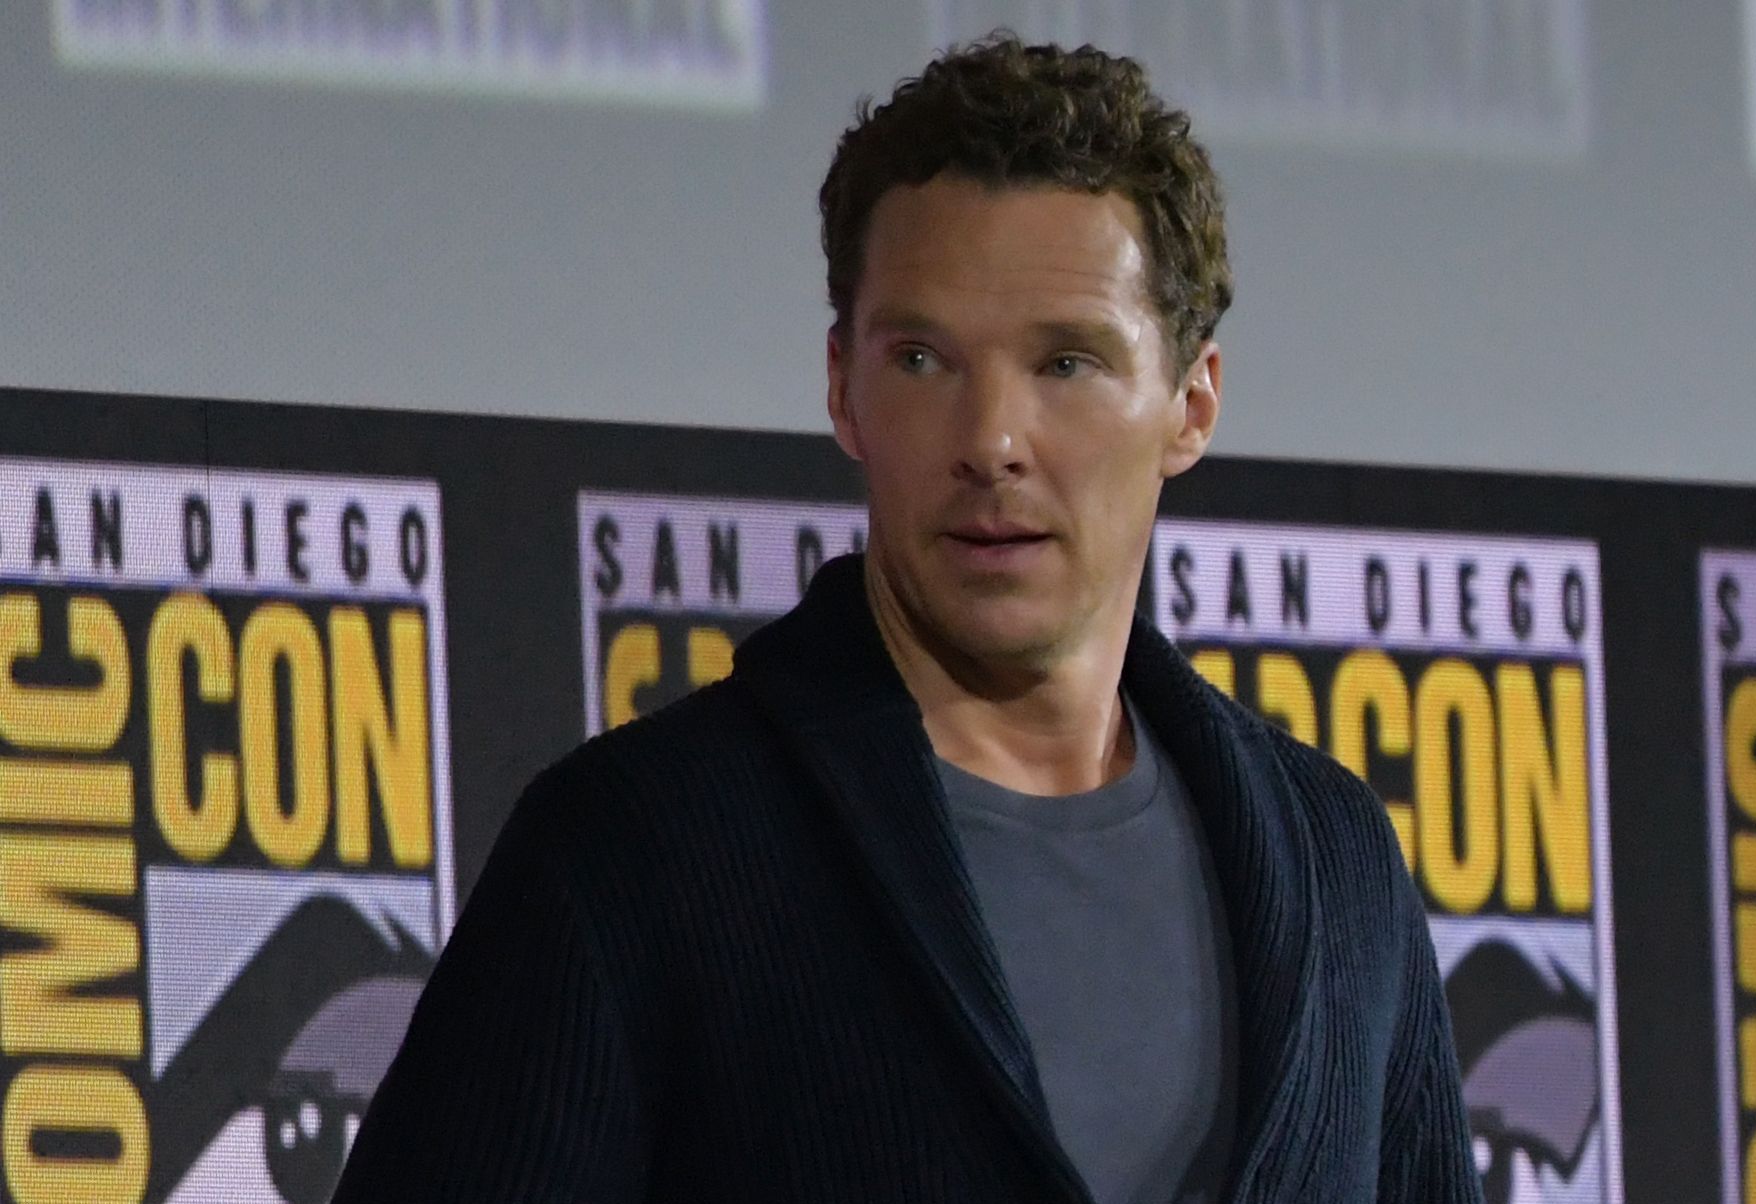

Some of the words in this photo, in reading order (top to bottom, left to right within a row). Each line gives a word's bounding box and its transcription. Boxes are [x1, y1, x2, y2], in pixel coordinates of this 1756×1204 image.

[31, 486, 122, 572] AN
[182, 492, 428, 586] DIEGO
[592, 514, 740, 602] SAN
[1169, 543, 1311, 629] SAN
[1364, 556, 1587, 644] DIEGO
[146, 588, 433, 868] CON
[1330, 648, 1593, 914] CON
